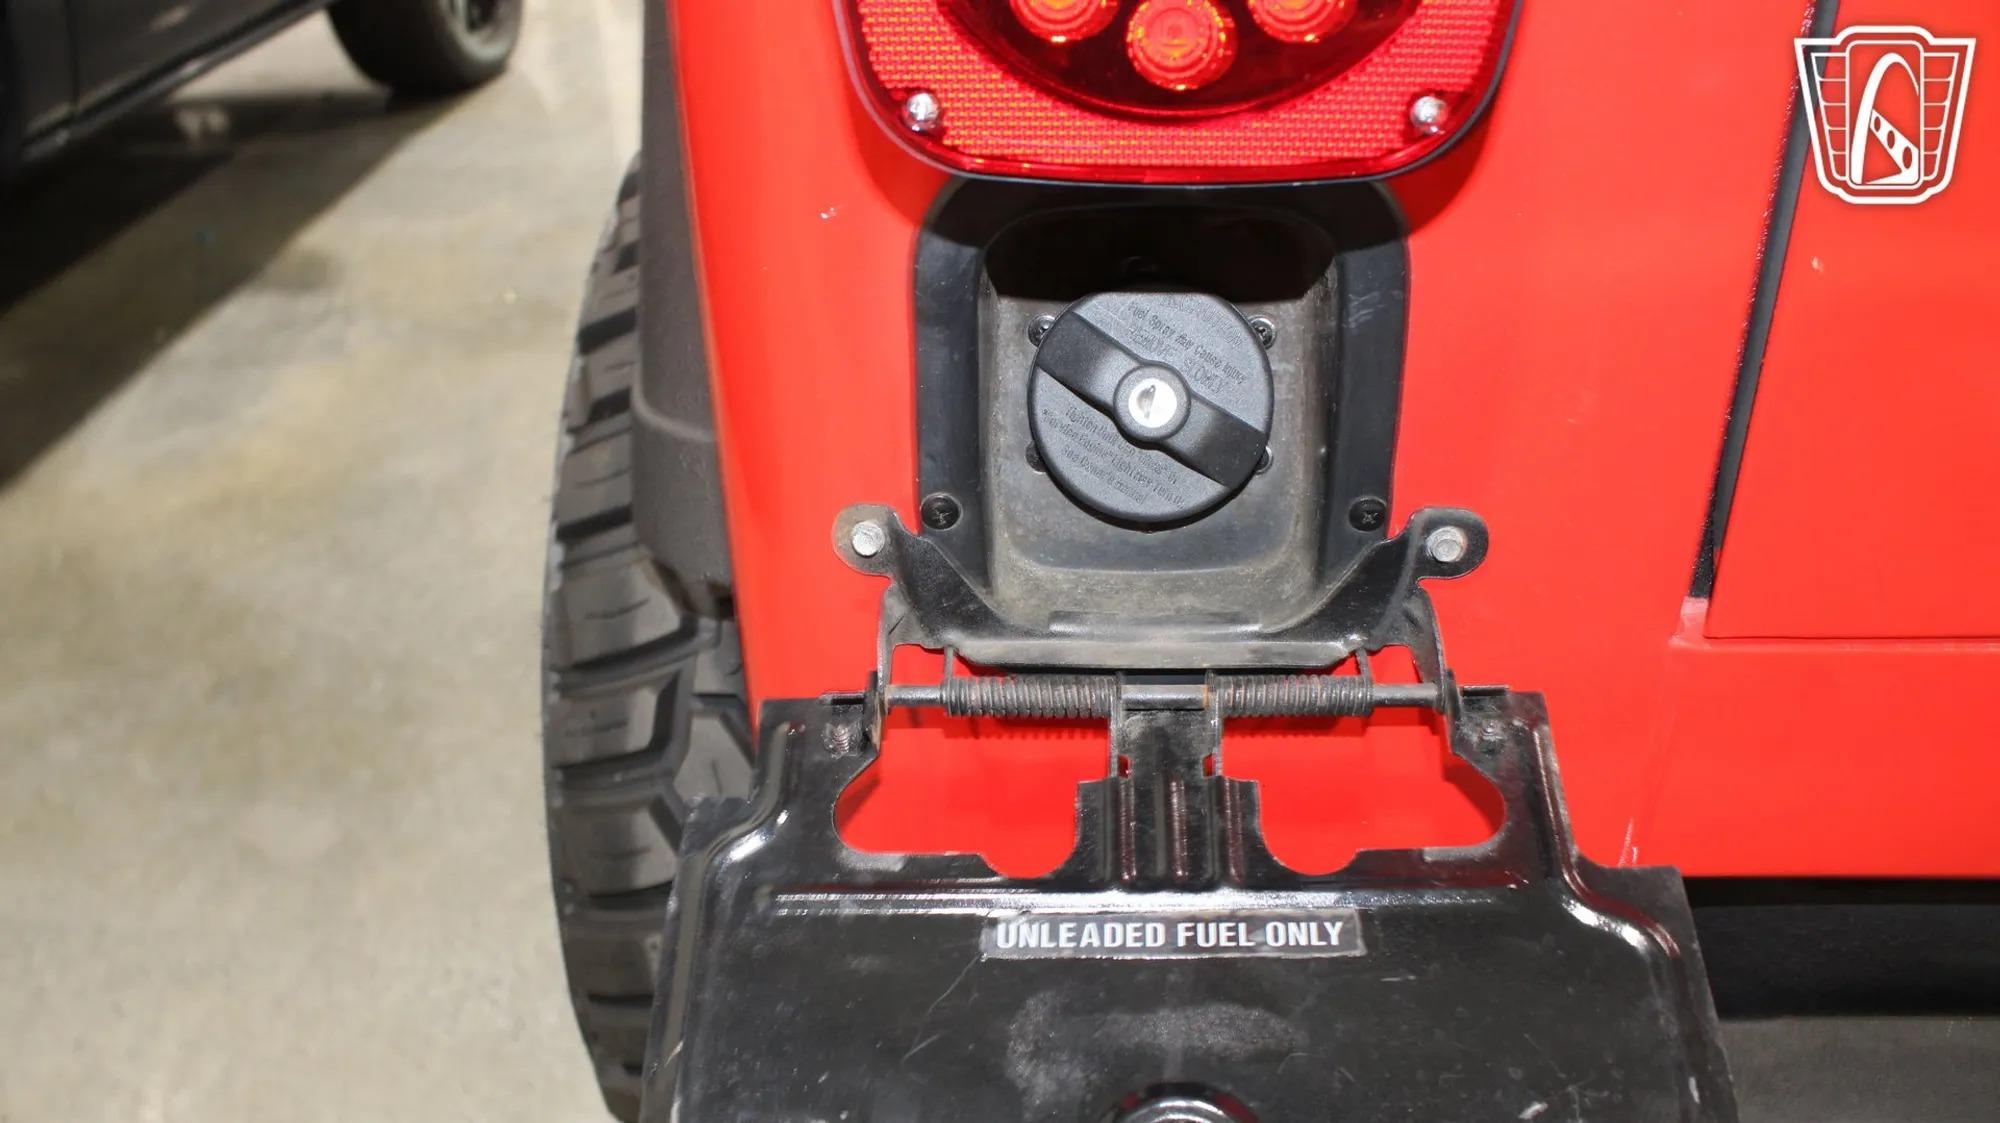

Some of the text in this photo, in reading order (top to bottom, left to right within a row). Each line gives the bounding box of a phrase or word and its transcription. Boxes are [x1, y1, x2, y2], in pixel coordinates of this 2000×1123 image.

[1147, 313, 1176, 339] Spray
[997, 921, 1343, 949] UNLEADED FUEL ONLY
